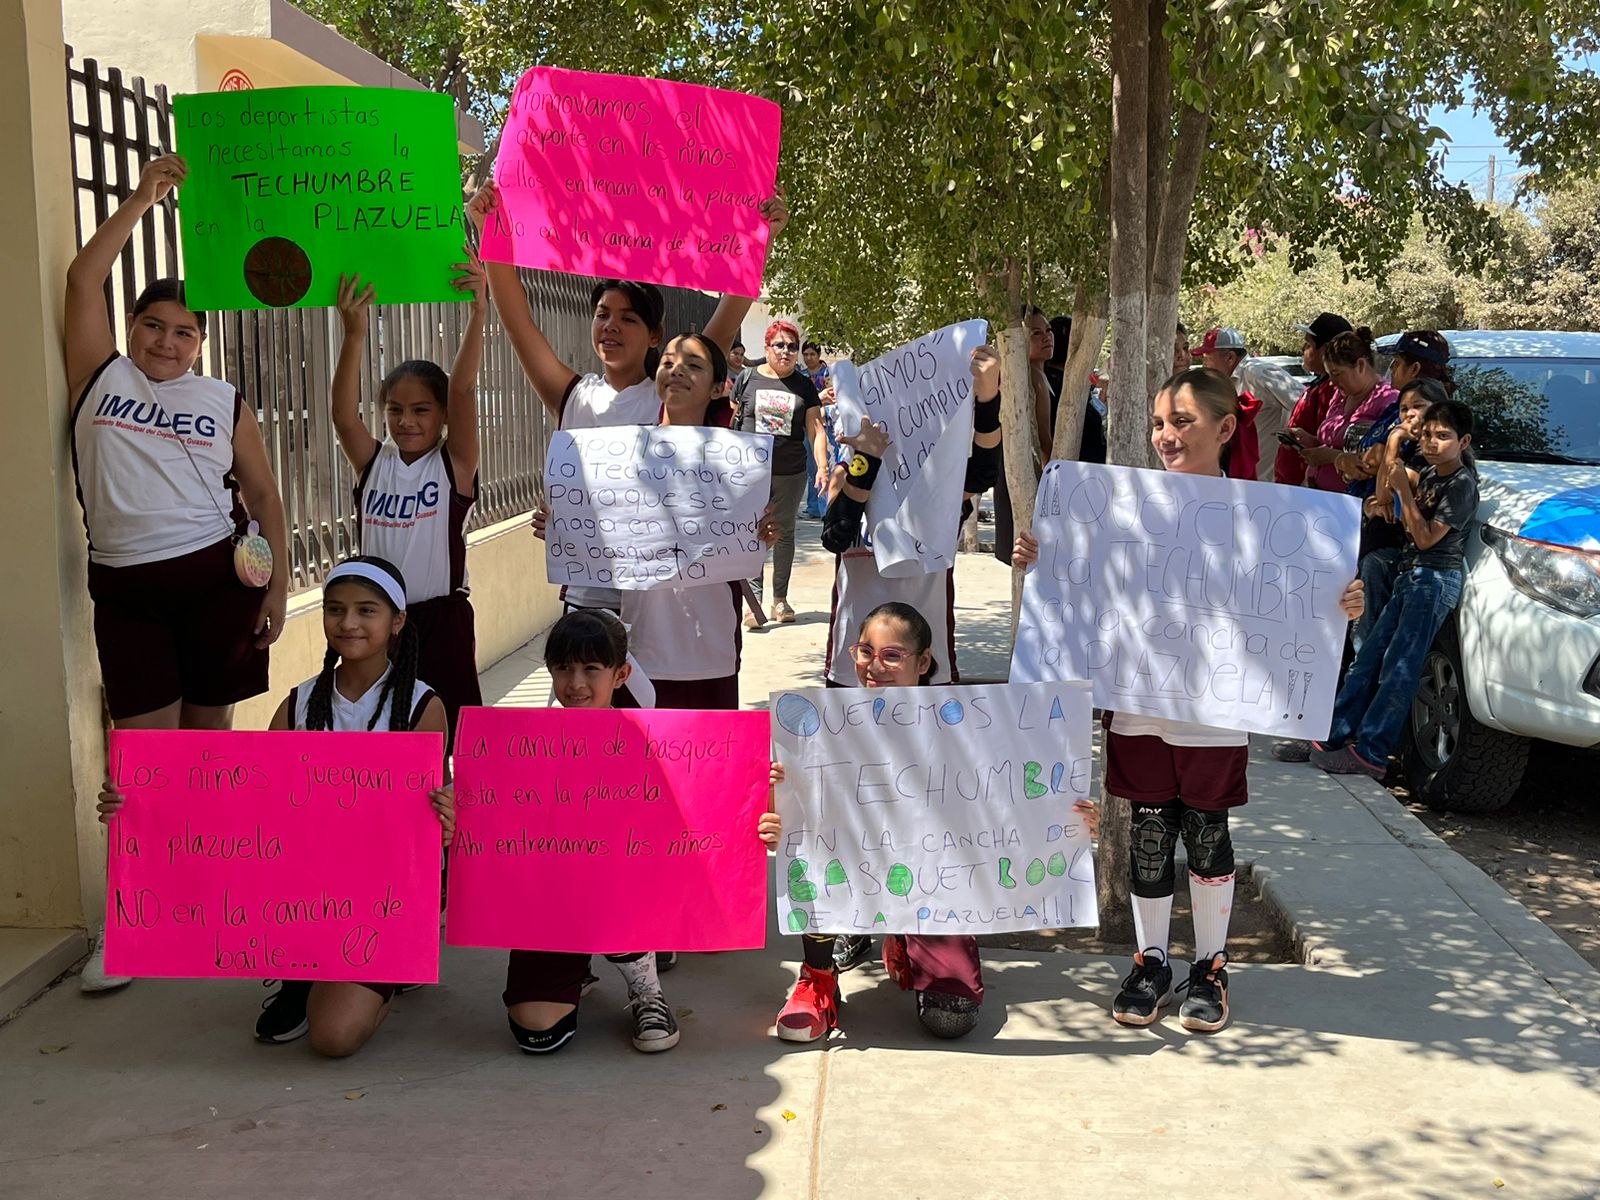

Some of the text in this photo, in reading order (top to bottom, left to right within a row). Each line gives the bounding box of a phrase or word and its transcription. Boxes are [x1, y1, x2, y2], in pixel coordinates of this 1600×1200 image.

[187, 97, 380, 133] Los deportistas
[515, 71, 701, 131] Promovamos el
[208, 133, 409, 165] necesitamos la
[599, 138, 625, 155] en
[642, 131, 668, 160] los
[231, 169, 415, 197] TECHUMBRE
[499, 159, 763, 212] Ellos entrenan en la plazuel
[194, 202, 464, 236] en la PLAZUELA
[494, 209, 744, 257] No en la cancha de baile
[589, 461, 749, 487] Techumbre
[551, 509, 618, 538] haga
[627, 516, 664, 535] en
[672, 516, 702, 536] la
[550, 540, 577, 558] de
[702, 545, 730, 557] en
[737, 537, 760, 553] la
[1110, 540, 1332, 621] TECHUMBRE
[1042, 597, 1316, 665] en la cancha de
[1039, 641, 1061, 667] la
[776, 692, 1066, 741] QUEREMOS LA
[456, 711, 738, 773] La cancha de basquet
[116, 748, 437, 810] Los niños juegan en
[456, 780, 500, 809] esta
[513, 785, 543, 805] en
[555, 776, 572, 804] la
[804, 757, 1092, 818] TECHUMBRE
[116, 814, 283, 865] la plazuela
[496, 827, 610, 857] entrenamos
[626, 827, 654, 857] los
[667, 829, 723, 856] niños
[785, 823, 1079, 858] EN LA CANCHA DE
[115, 885, 404, 929] NO en la cancha de
[787, 907, 831, 933] DE
[853, 910, 888, 929] LA
